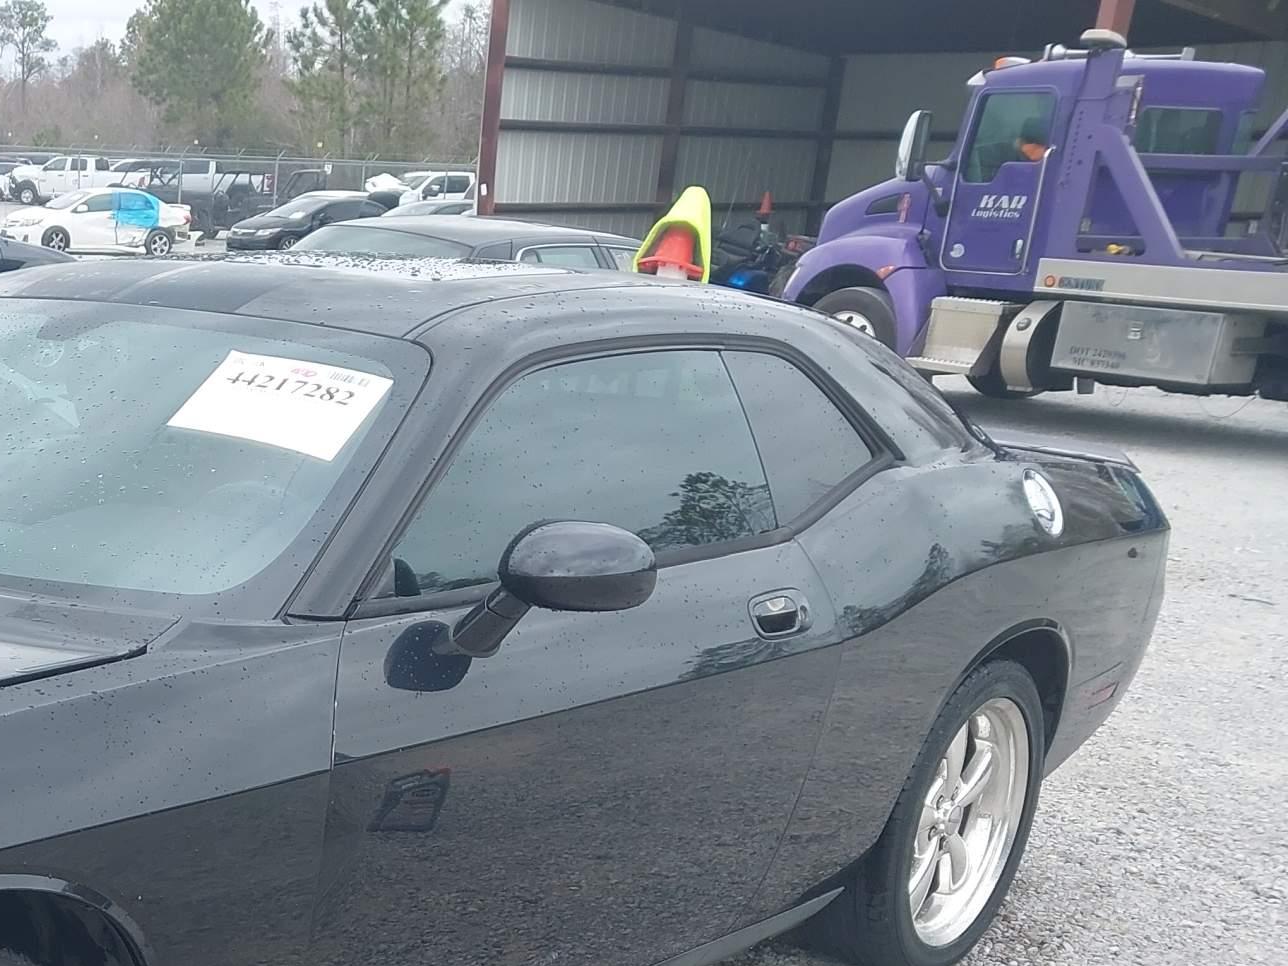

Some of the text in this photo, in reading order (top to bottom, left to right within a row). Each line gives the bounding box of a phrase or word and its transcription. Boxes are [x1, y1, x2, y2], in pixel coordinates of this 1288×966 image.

[979, 194, 1028, 208] KAR
[970, 208, 1021, 218] Logistics
[226, 371, 355, 406] 44217282
